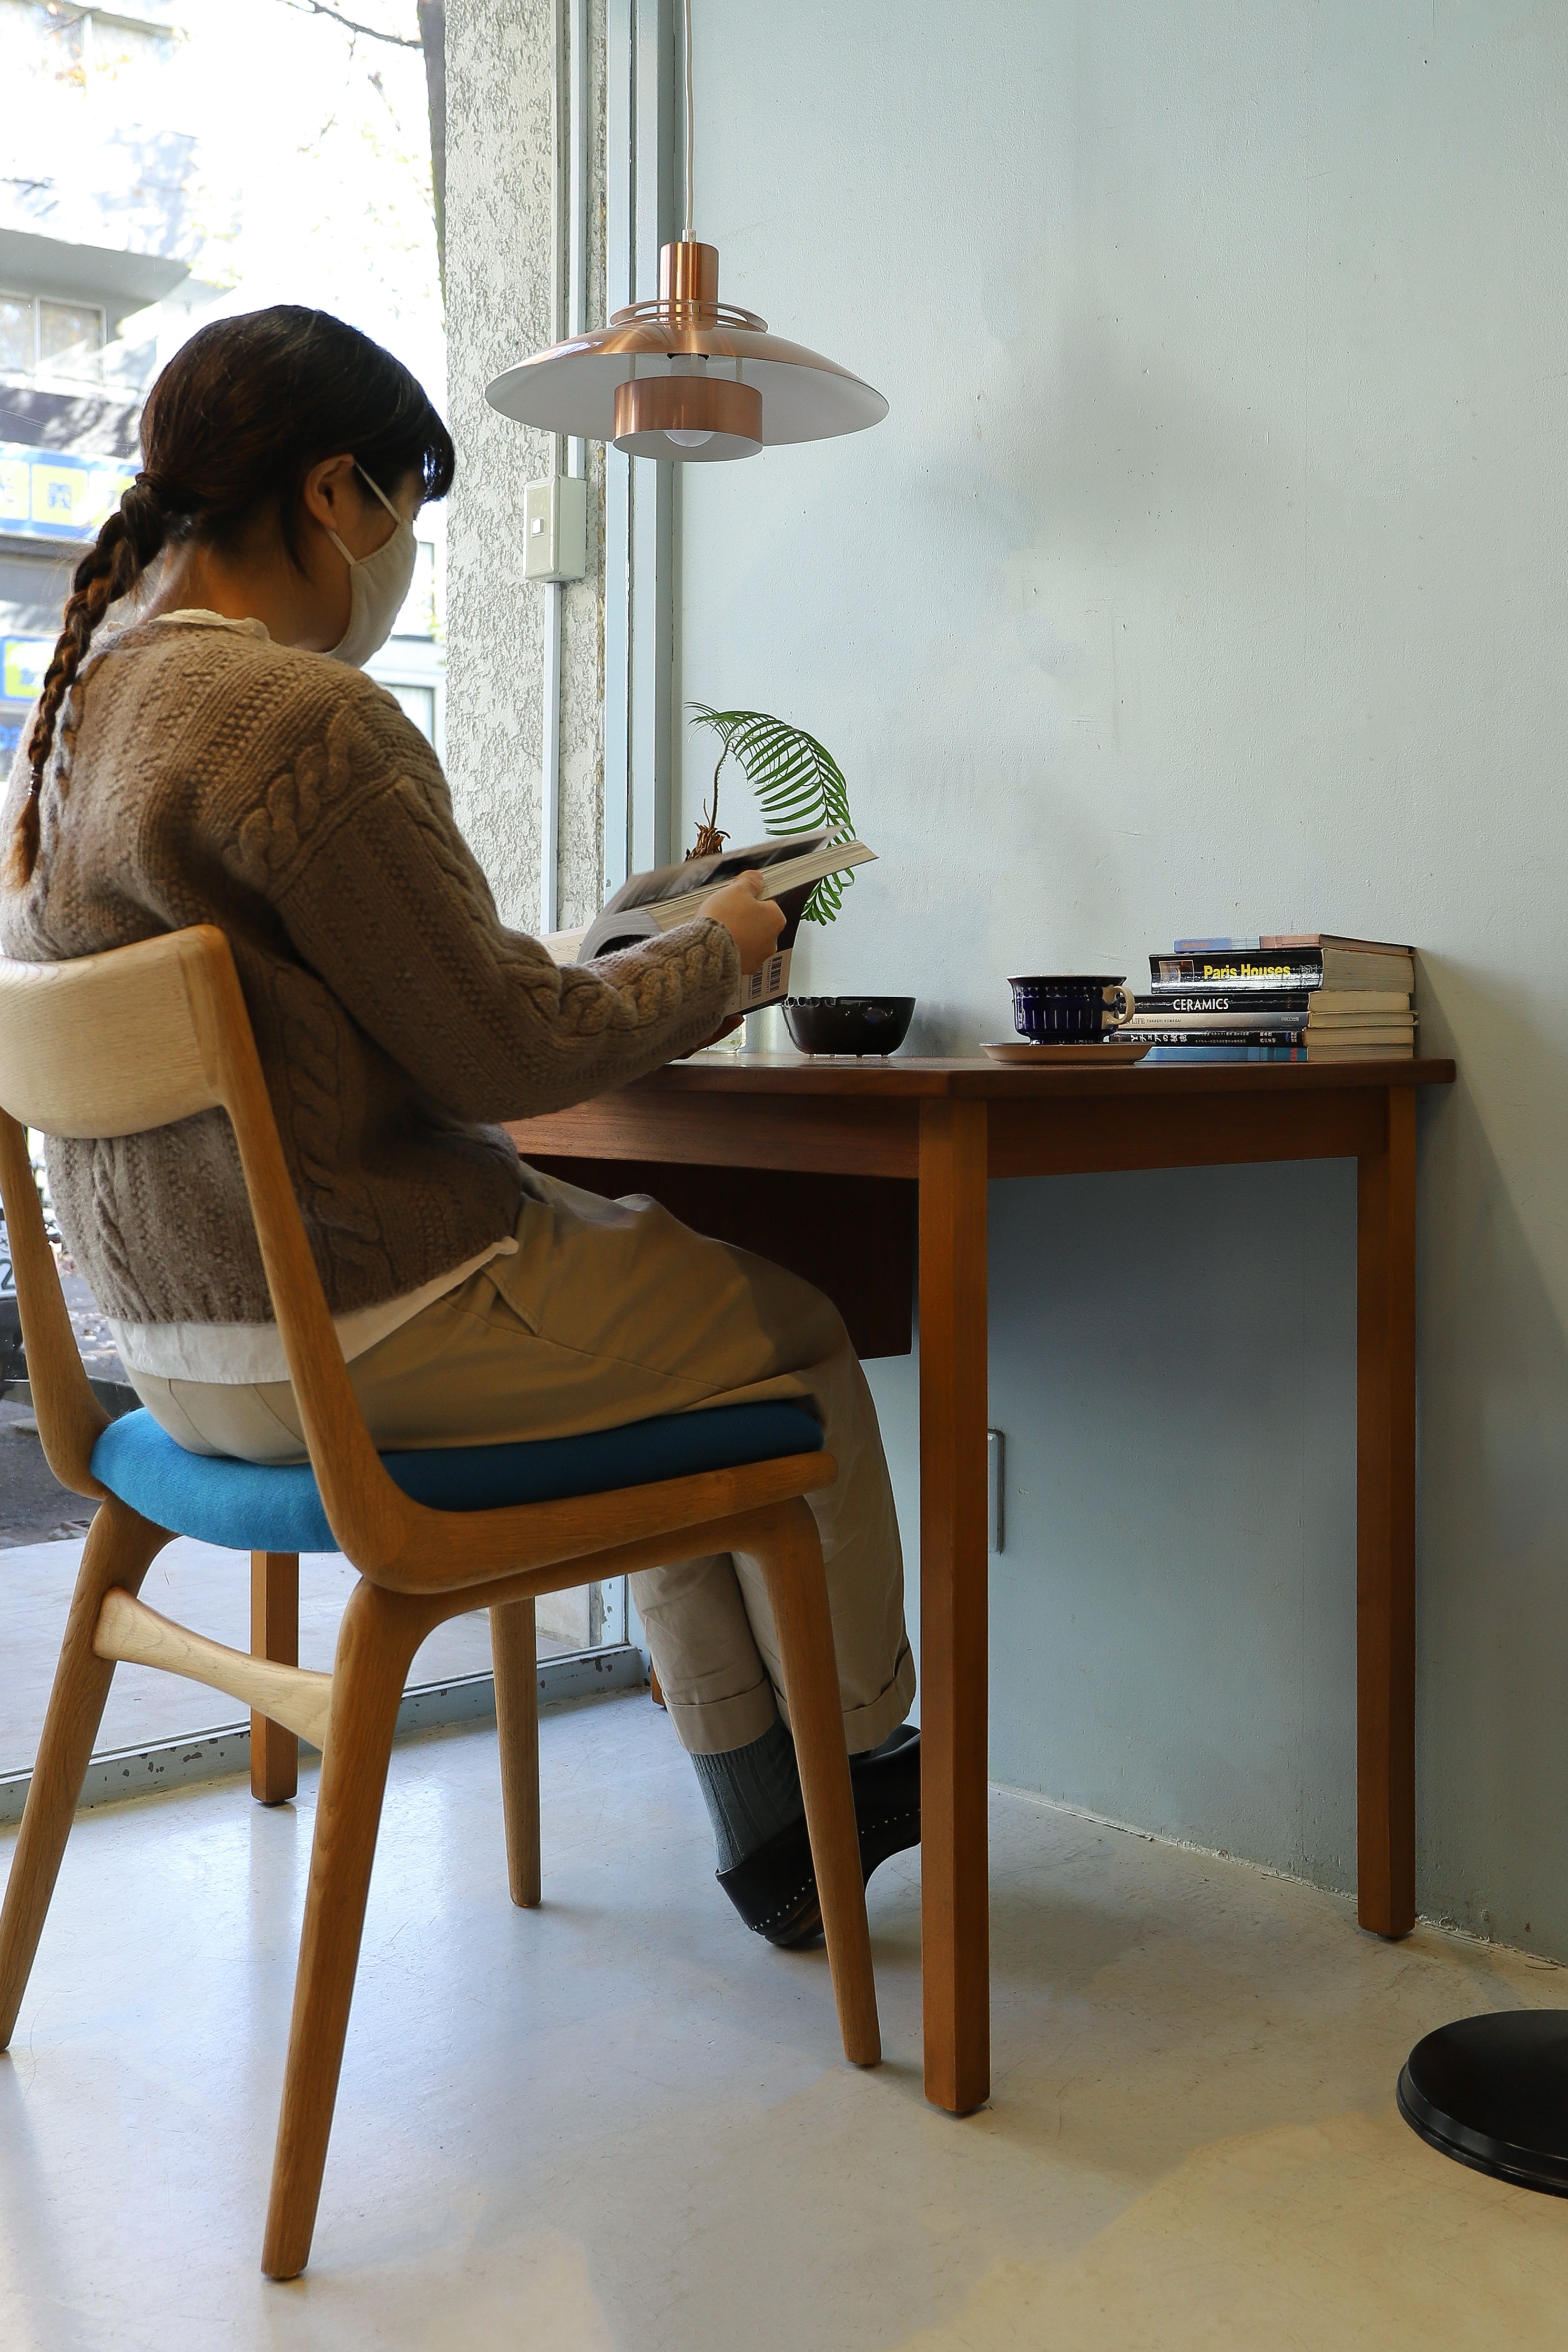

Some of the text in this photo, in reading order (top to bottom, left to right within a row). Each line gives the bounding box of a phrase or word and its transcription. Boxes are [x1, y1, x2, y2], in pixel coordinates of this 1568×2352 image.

[1204, 964, 1291, 979] Paris Houses
[1173, 998, 1229, 1011] CERAMICS
